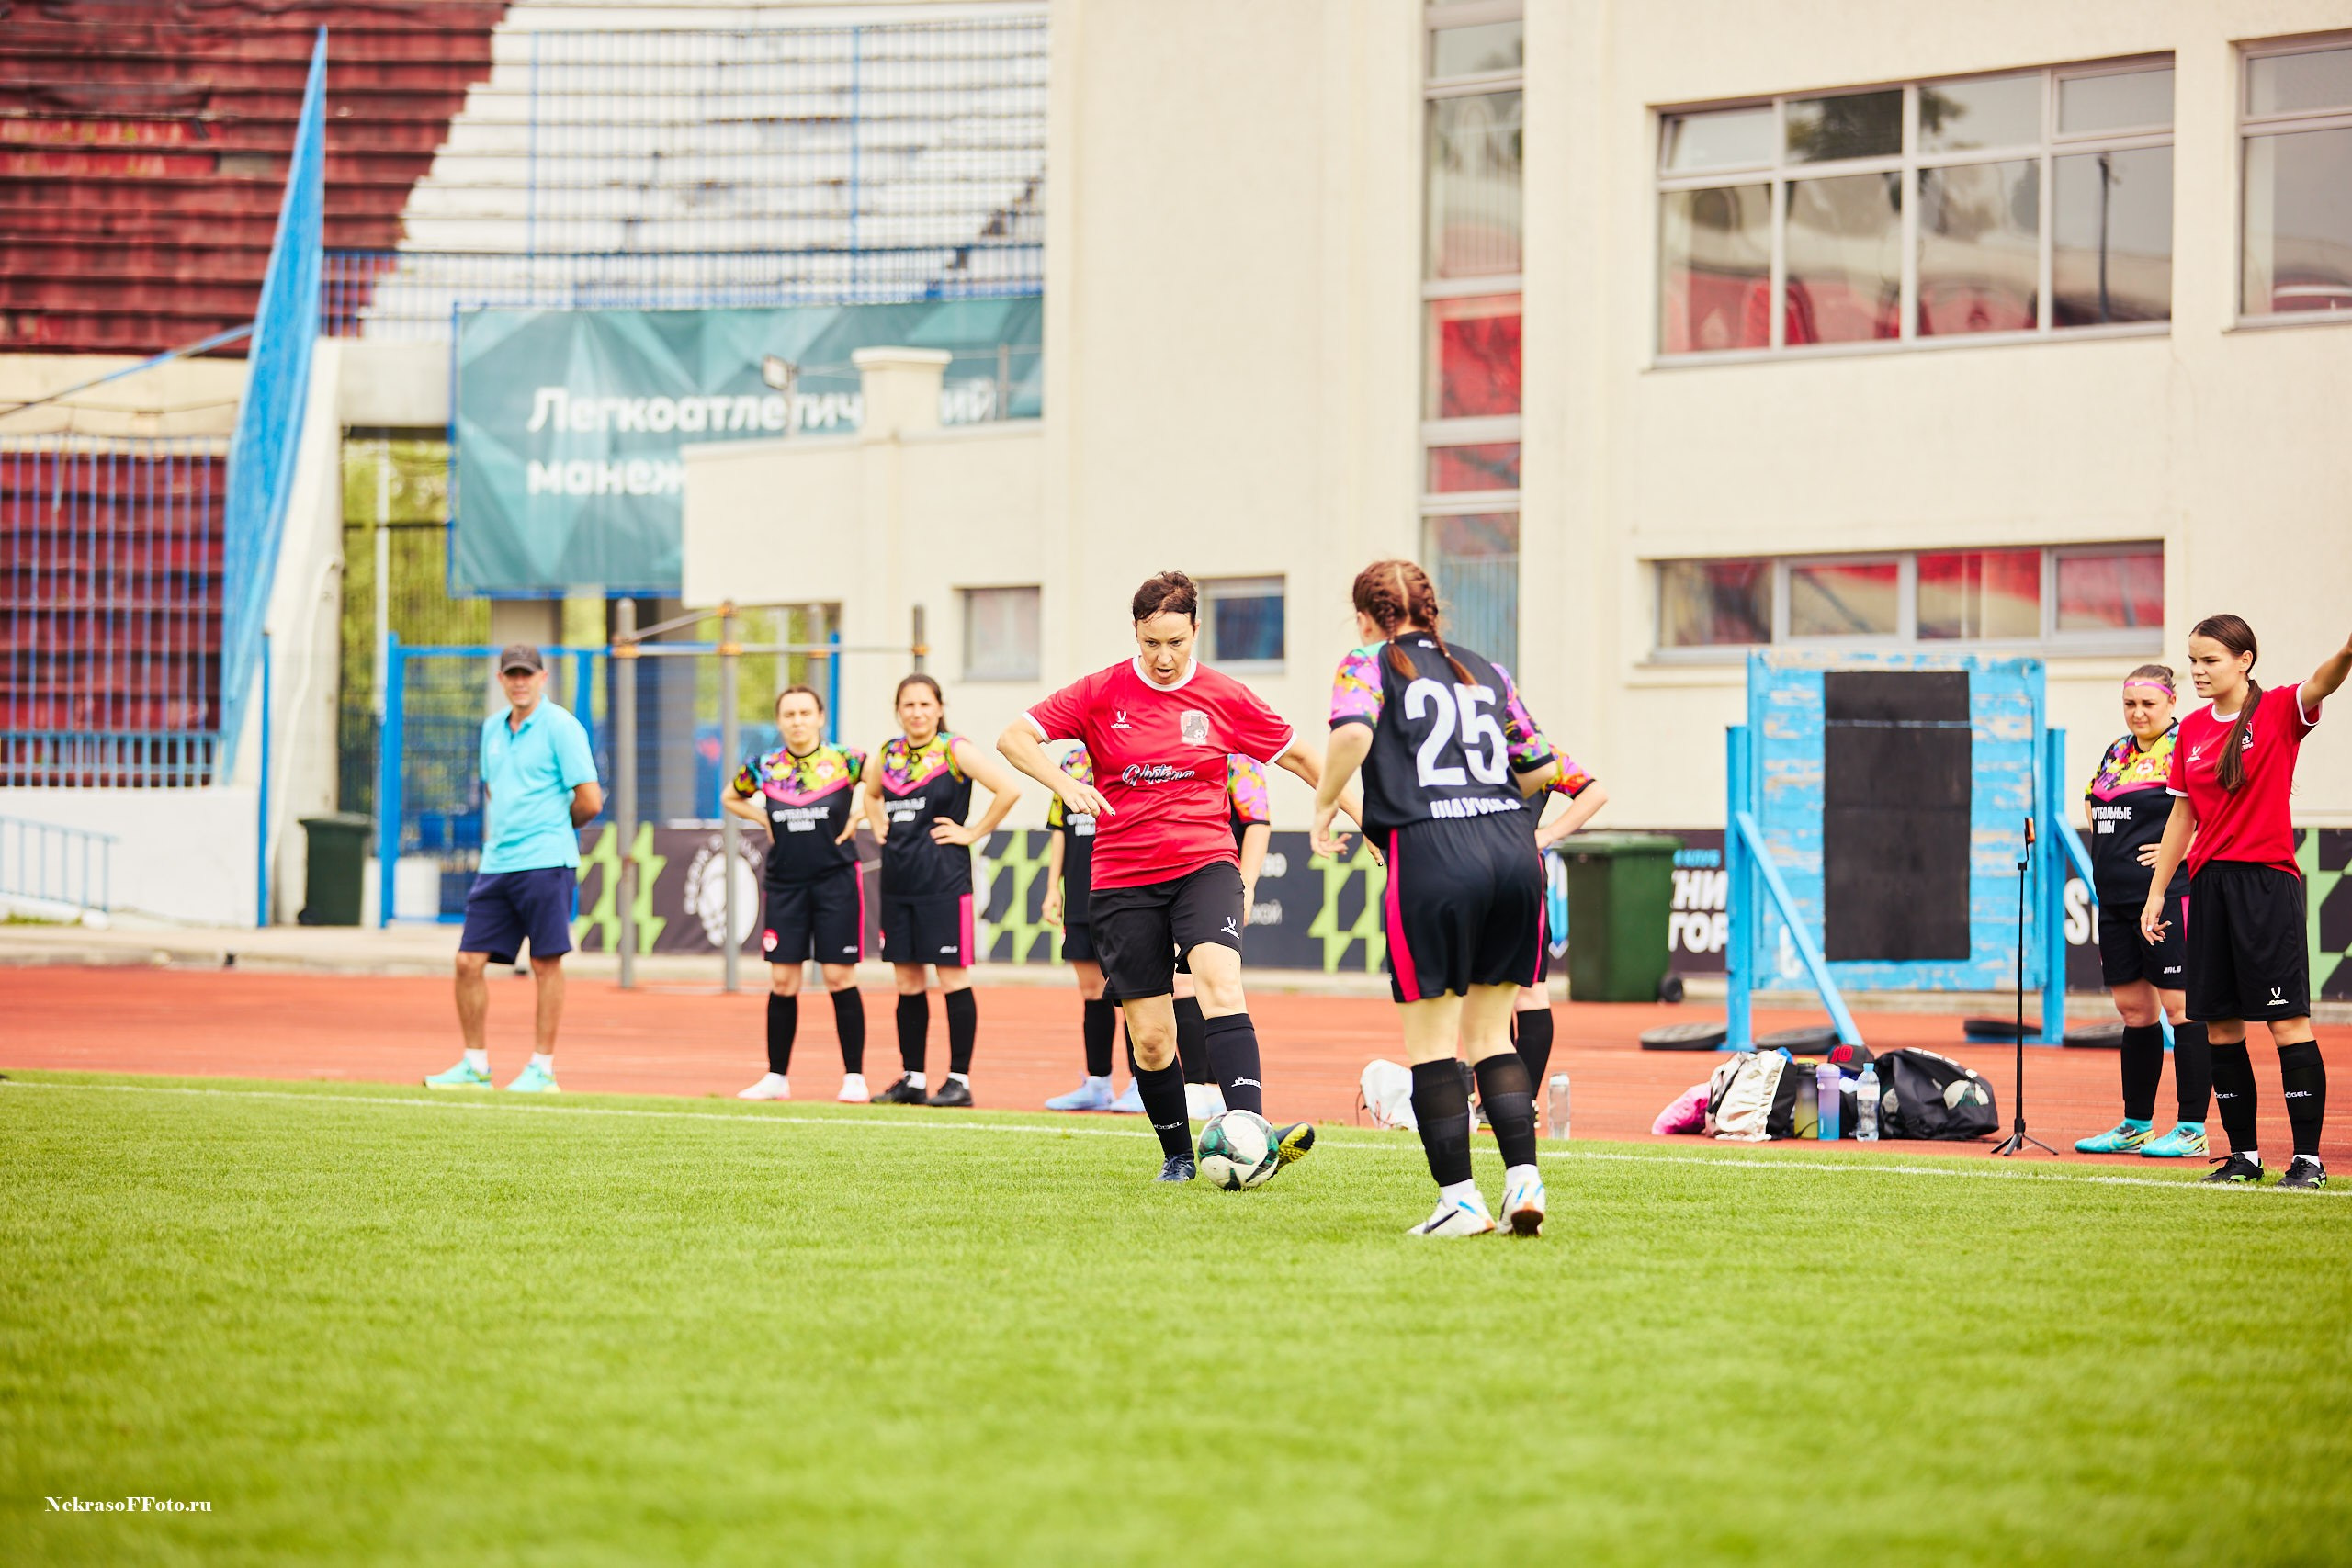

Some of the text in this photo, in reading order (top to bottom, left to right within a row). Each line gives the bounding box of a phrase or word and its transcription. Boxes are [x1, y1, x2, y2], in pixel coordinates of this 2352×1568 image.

[526, 378, 997, 433] Легкоатлетичий
[1404, 678, 1510, 787] 25
[1830, 1043, 1854, 1064] 10
